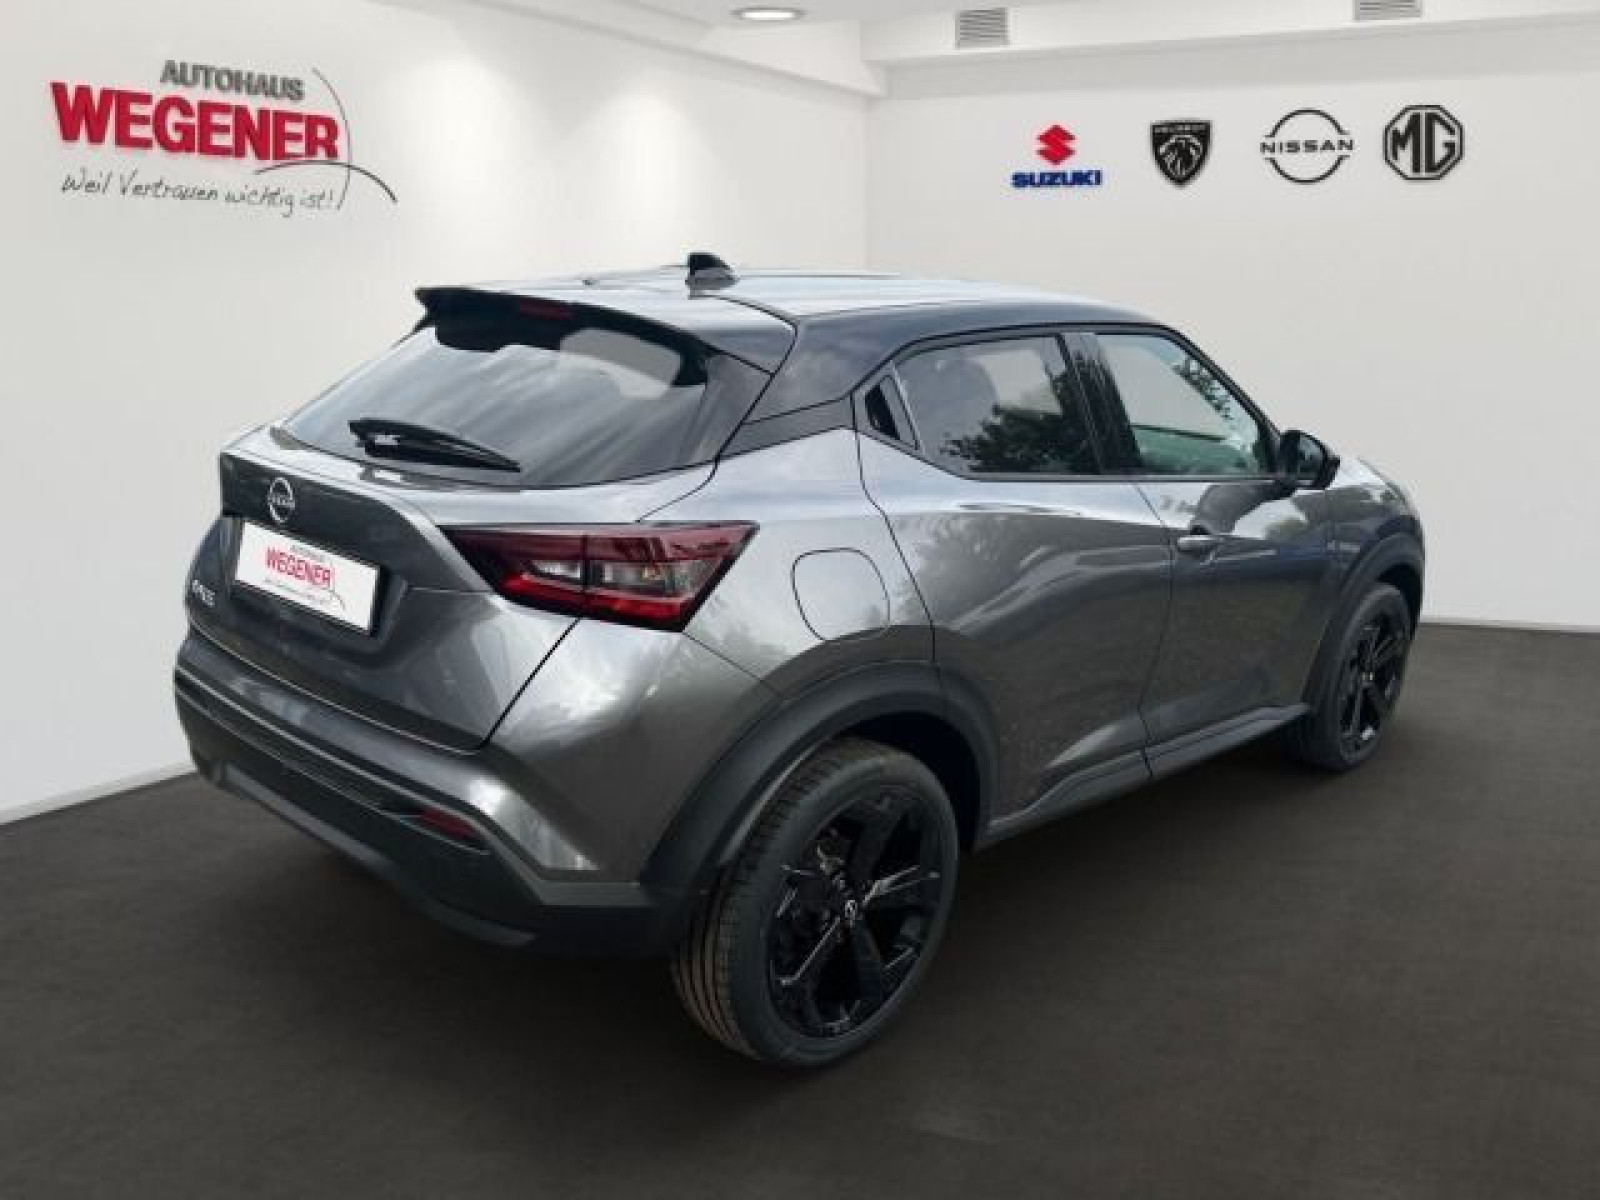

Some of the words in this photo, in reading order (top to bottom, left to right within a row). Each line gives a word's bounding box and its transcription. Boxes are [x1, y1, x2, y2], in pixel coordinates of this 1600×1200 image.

[160, 59, 305, 101] AUTOHAUS
[50, 81, 340, 161] WEGENER
[1260, 140, 1354, 154] NISSAN
[1391, 111, 1458, 174] MG
[61, 166, 112, 195] Weil
[119, 168, 218, 201] Vertrauen
[224, 184, 294, 218] wichtig
[1011, 170, 1103, 188] SUZUKI
[266, 547, 331, 588] WEGENER
